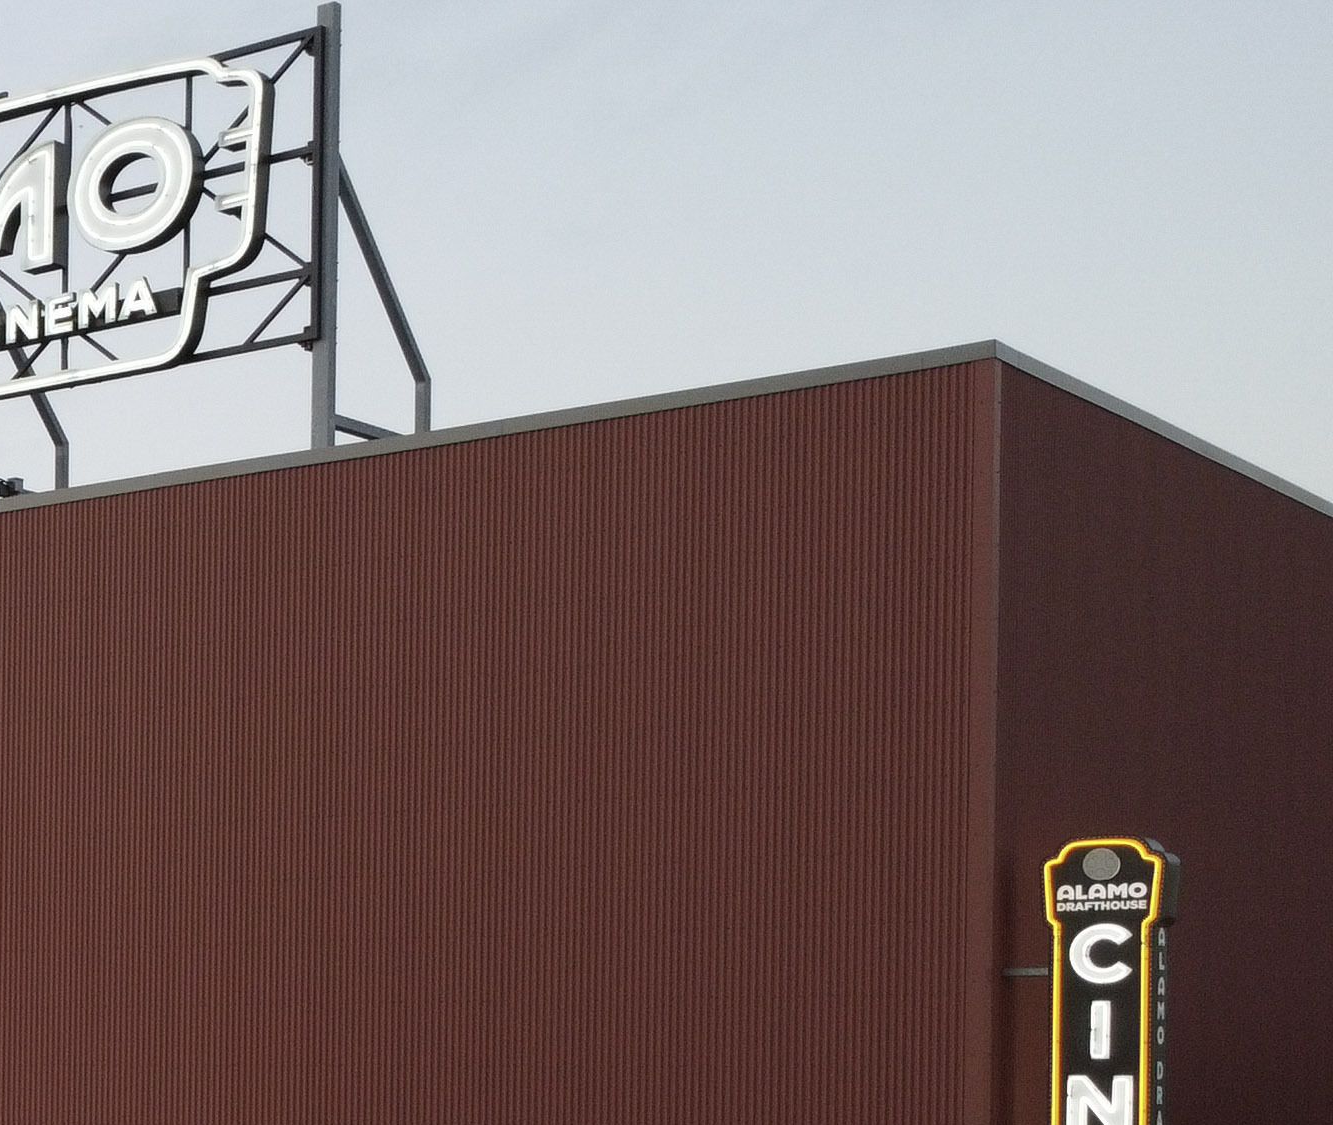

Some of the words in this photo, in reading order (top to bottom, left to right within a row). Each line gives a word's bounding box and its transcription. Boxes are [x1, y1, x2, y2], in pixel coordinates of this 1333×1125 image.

[1056, 882, 1147, 900] ALAMO
[1056, 900, 1147, 911] DRAFTHOUSE
[1156, 927, 1165, 1044] ALAMO
